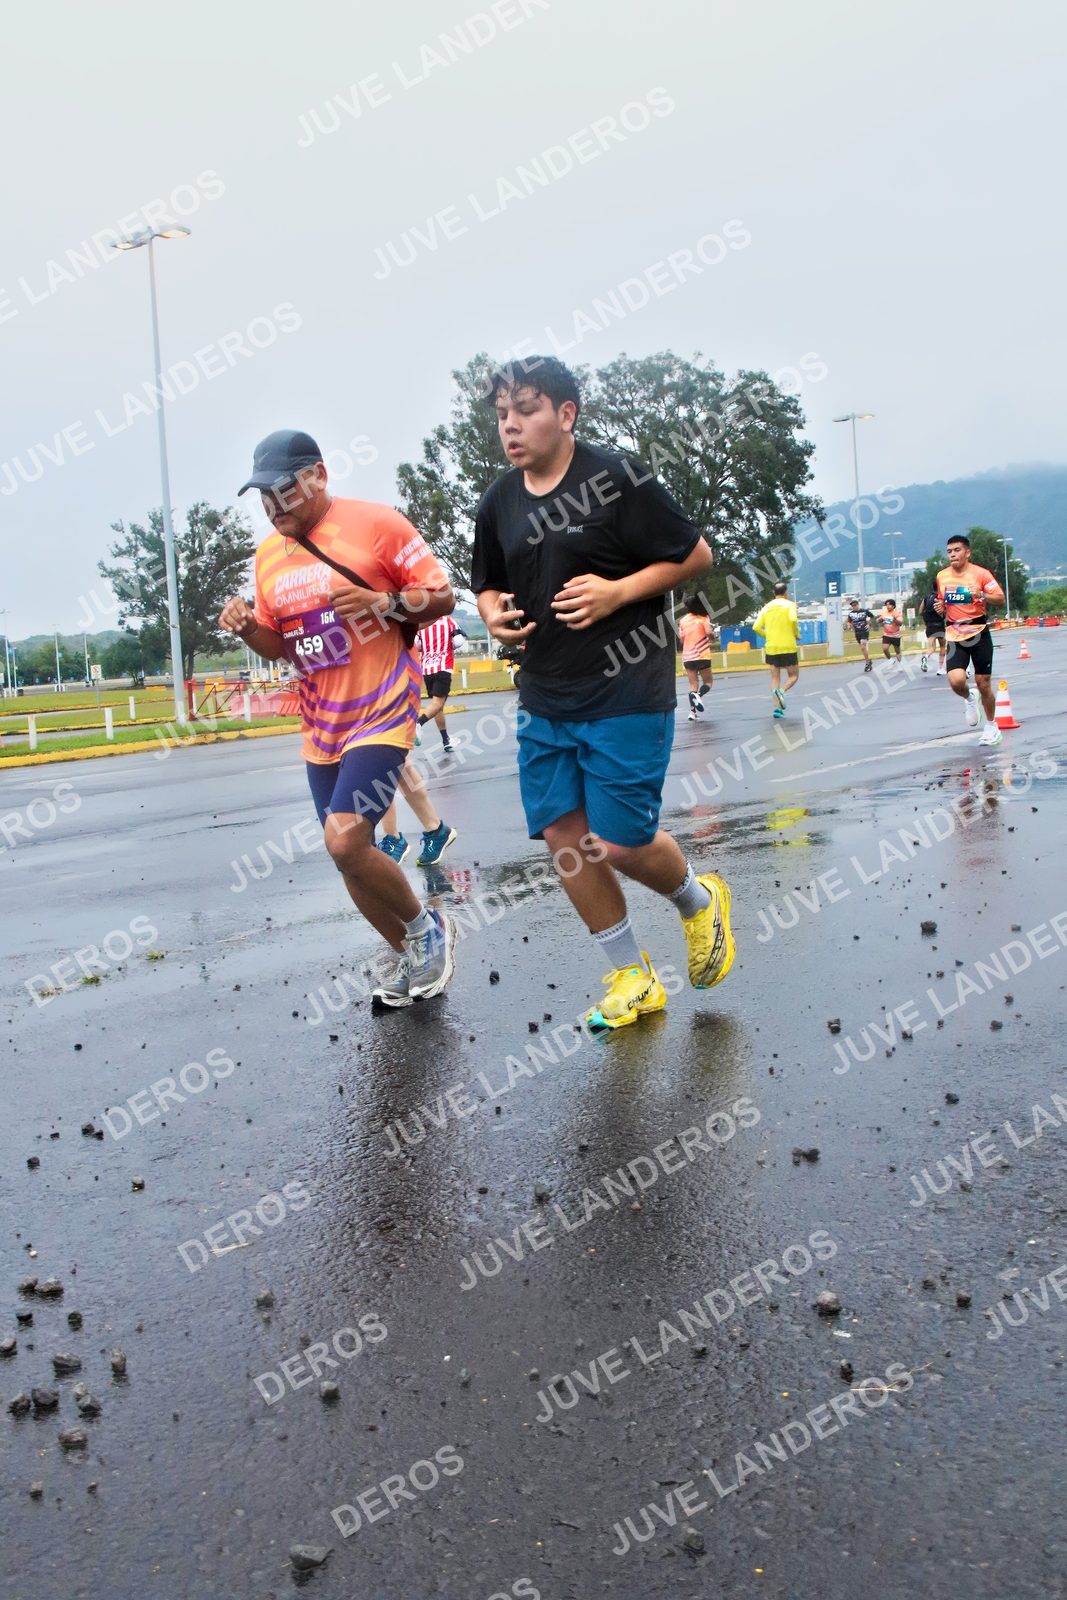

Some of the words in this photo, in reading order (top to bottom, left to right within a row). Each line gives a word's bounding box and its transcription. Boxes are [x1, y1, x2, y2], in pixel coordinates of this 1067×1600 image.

[275, 562, 331, 595] CARRERA
[828, 581, 838, 594] E
[276, 584, 320, 607] OMNILIFE
[948, 593, 965, 602] 1285
[295, 635, 324, 656] 459
